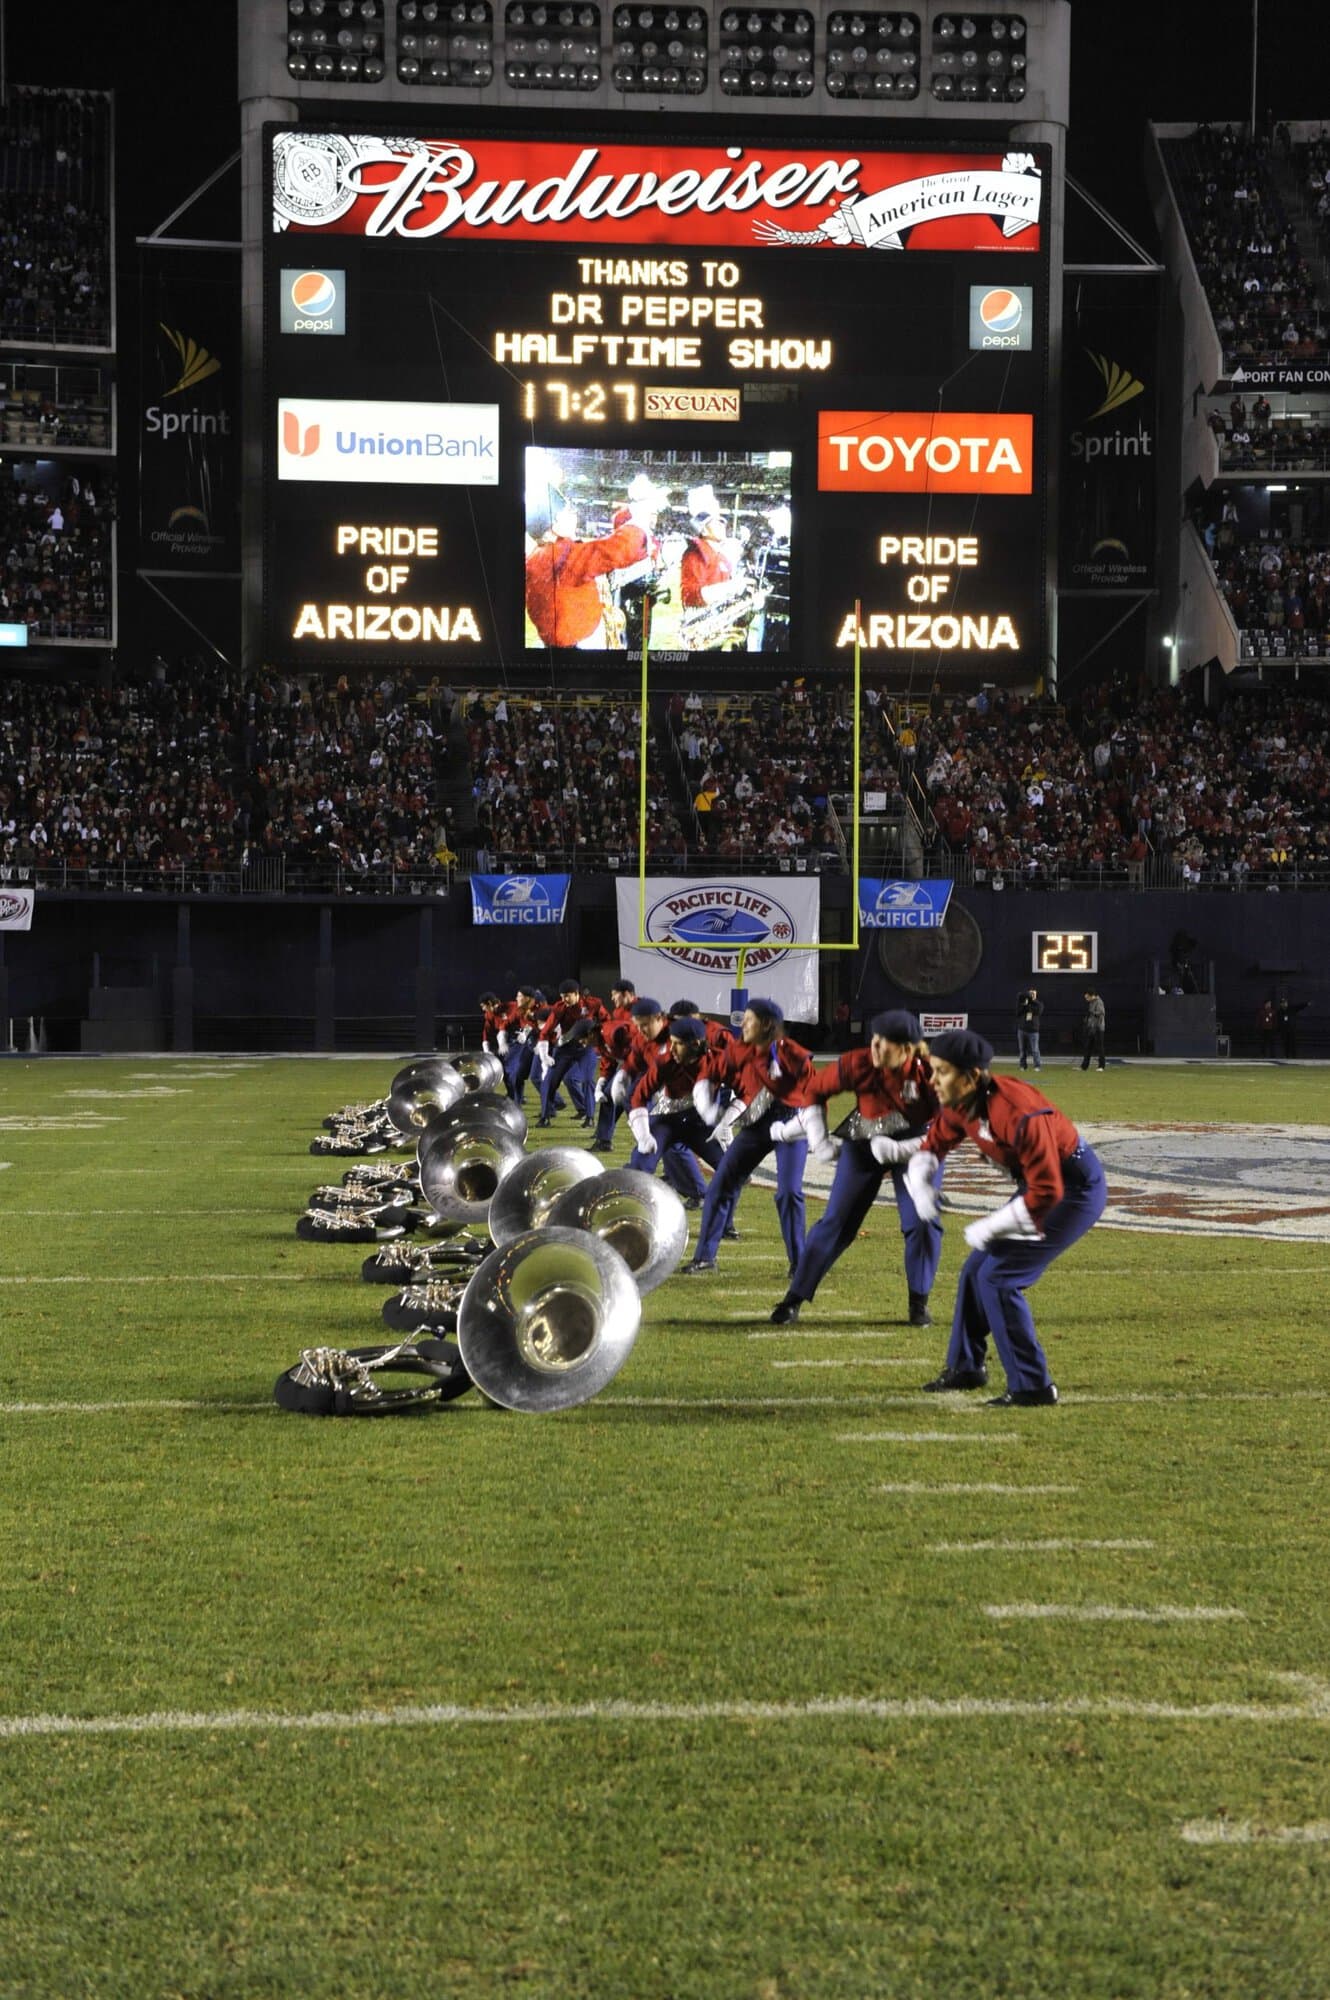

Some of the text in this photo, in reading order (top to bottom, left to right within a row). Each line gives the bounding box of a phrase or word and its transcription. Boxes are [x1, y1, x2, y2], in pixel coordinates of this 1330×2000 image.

[343, 147, 860, 239] Budweiser
[868, 185, 1034, 233] American Lager
[578, 258, 740, 288] THANKS TO
[294, 318, 333, 333] pepsi
[551, 294, 764, 329] DR PEPPER
[494, 333, 832, 371] HALFTIME SHOW
[982, 333, 1020, 348] pepsi
[1241, 371, 1275, 383] PORT
[1279, 371, 1303, 382] FAN
[525, 382, 636, 421] 17:27
[647, 394, 738, 413] SYCUAN
[146, 406, 230, 440] Sprint
[336, 432, 494, 458] UnionBank
[829, 436, 1022, 474] TOYOTA
[1071, 430, 1151, 463] Sprint
[337, 525, 439, 557] PRIDE
[880, 536, 978, 566] PRIDE
[366, 566, 410, 594] OF
[908, 576, 950, 603] OF
[293, 605, 482, 643] ARIZONA
[836, 614, 1020, 650] ARIZONA
[473, 905, 561, 924] PACIFIC LIF
[665, 891, 773, 918] PACIFIC LIFE
[859, 910, 943, 927] PACIFIC LIF
[1042, 934, 1088, 969] 25
[923, 1016, 964, 1028] ESPN
